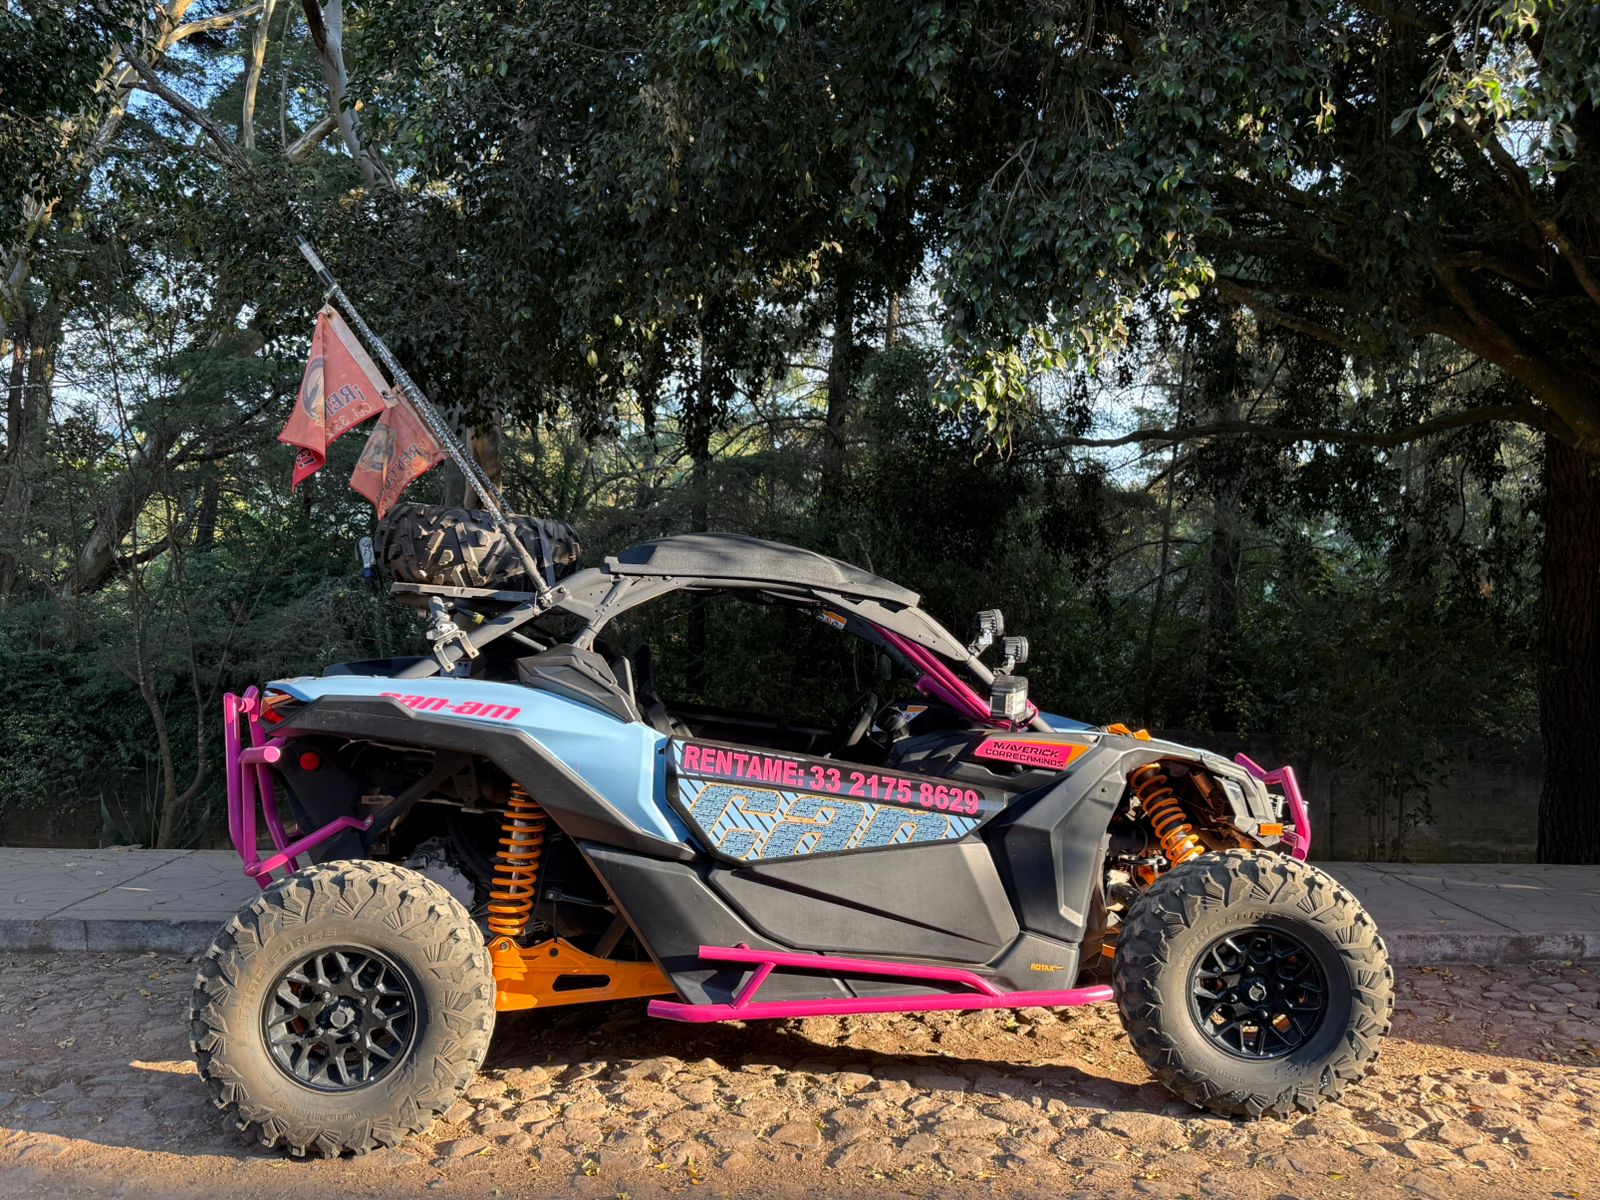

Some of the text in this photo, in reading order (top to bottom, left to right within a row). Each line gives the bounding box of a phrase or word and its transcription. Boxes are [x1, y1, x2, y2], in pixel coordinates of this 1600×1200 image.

[985, 748, 1064, 768] CORRECAMINOS
[993, 741, 1060, 758] MAVERICK
[684, 745, 979, 815] RENTAME: 33 2175 8629
[268, 928, 337, 965] FORCE
